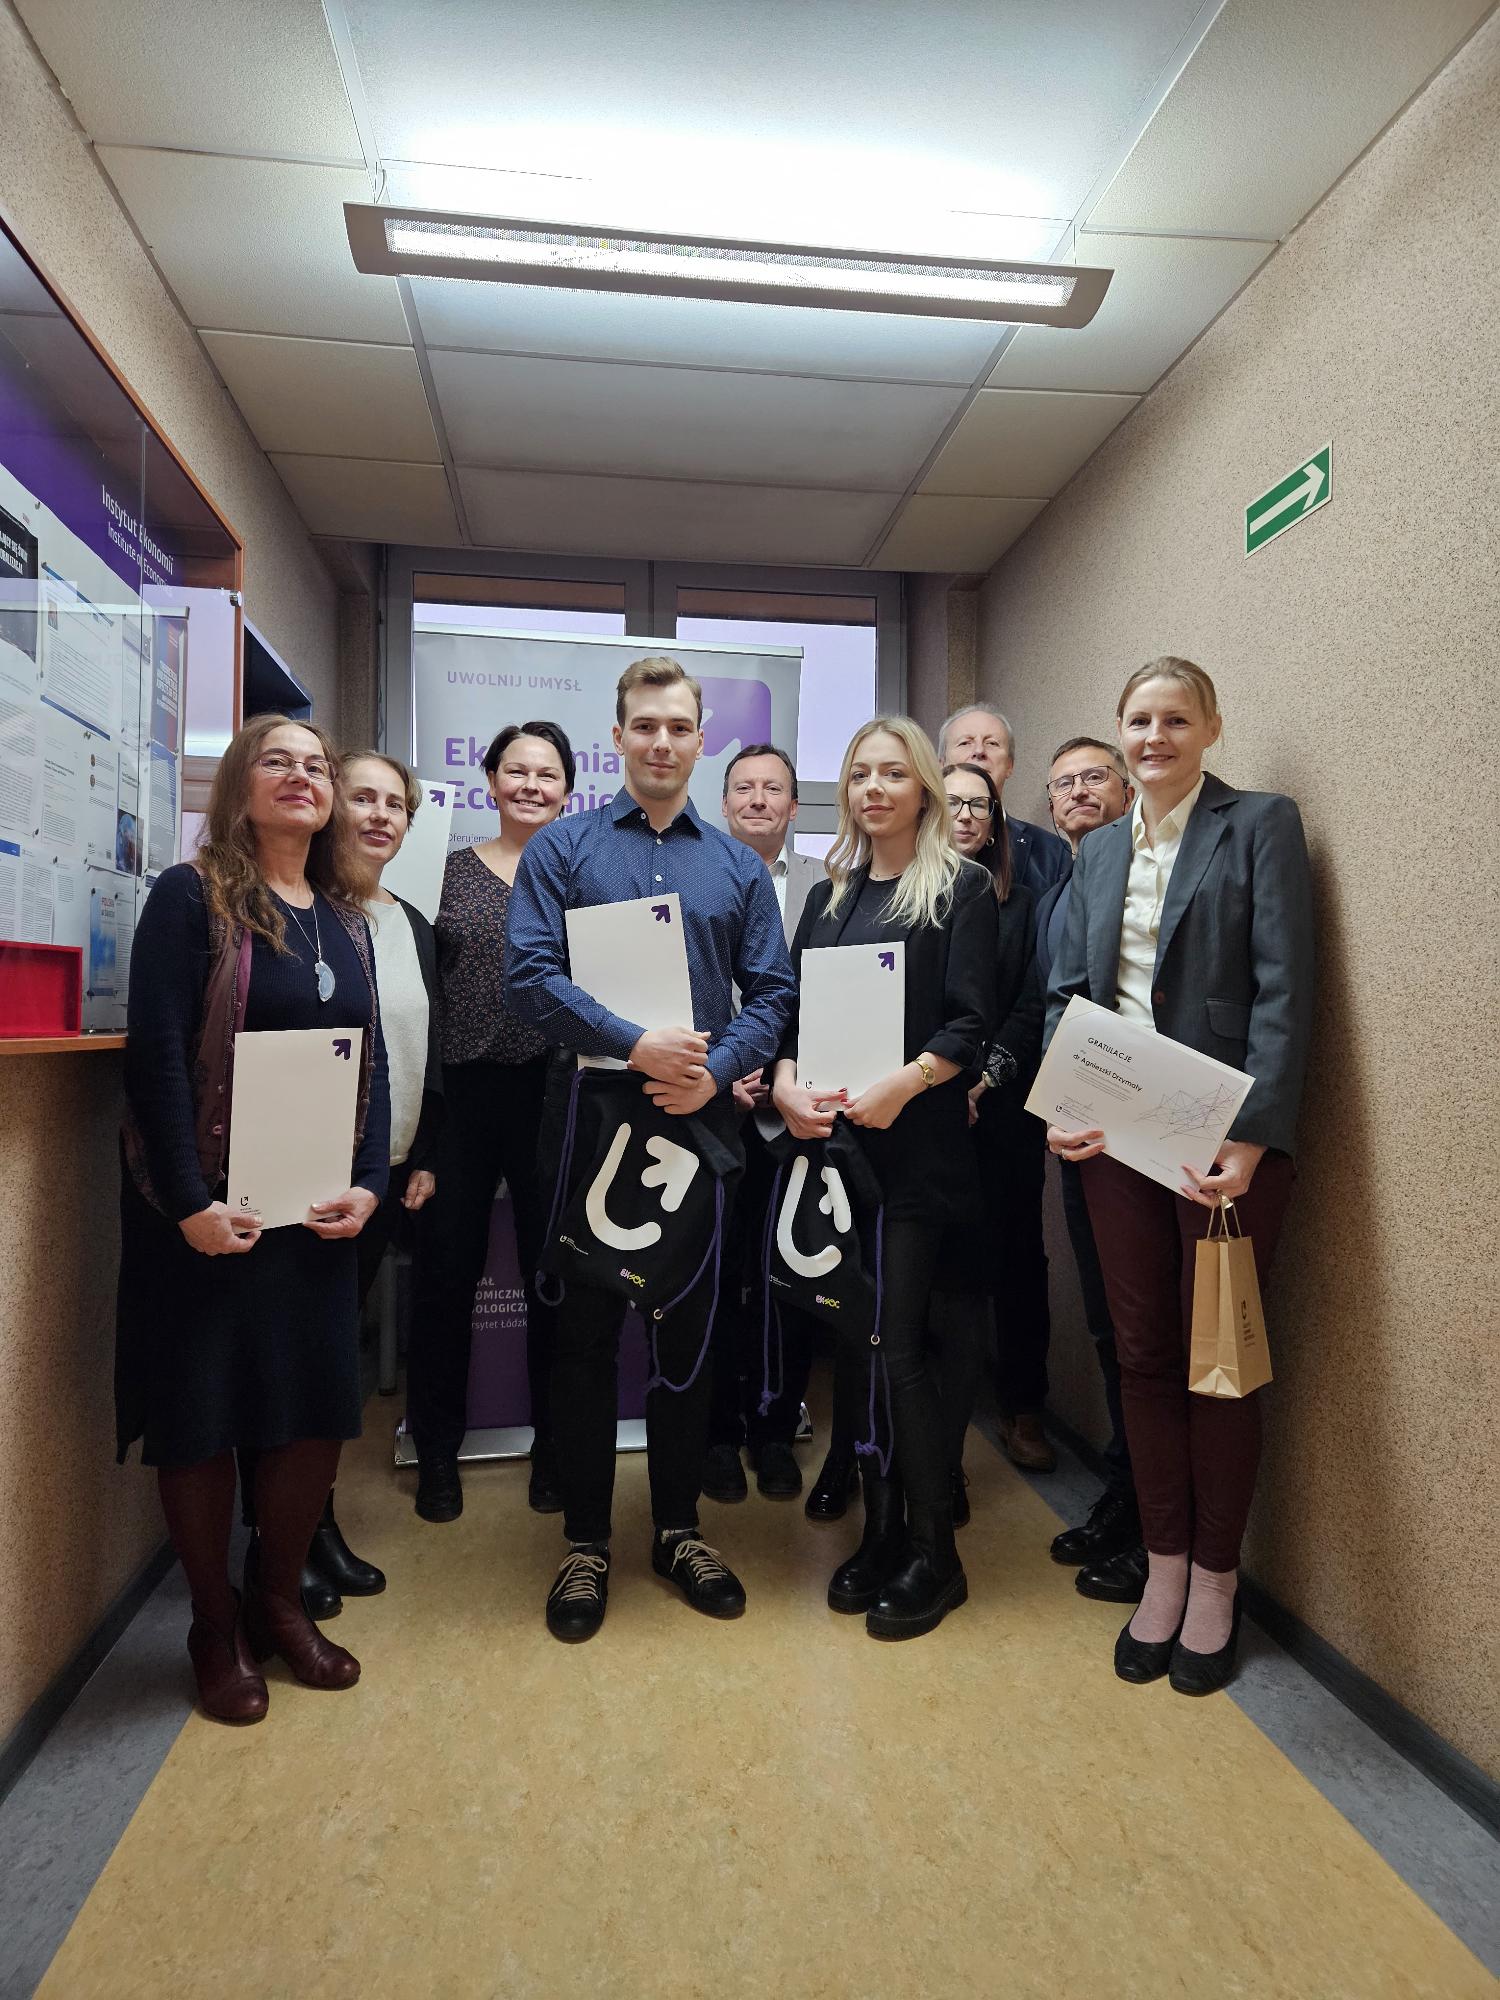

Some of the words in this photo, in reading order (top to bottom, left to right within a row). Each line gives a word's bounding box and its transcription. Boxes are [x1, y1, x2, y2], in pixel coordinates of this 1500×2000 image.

[101, 484, 138, 538] Instytut
[139, 523, 174, 575] Ekonomii
[107, 521, 136, 561] Institute
[447, 670, 522, 687] UWOLNIJ
[528, 676, 582, 692] UMYSŁ
[1087, 1037, 1132, 1063] GRATULACJE
[1081, 1057, 1112, 1076] Agnieszki
[475, 1288, 526, 1301] OMICZN
[472, 1302, 528, 1314] OLOGICZ
[500, 1317, 528, 1329] Łódzk
